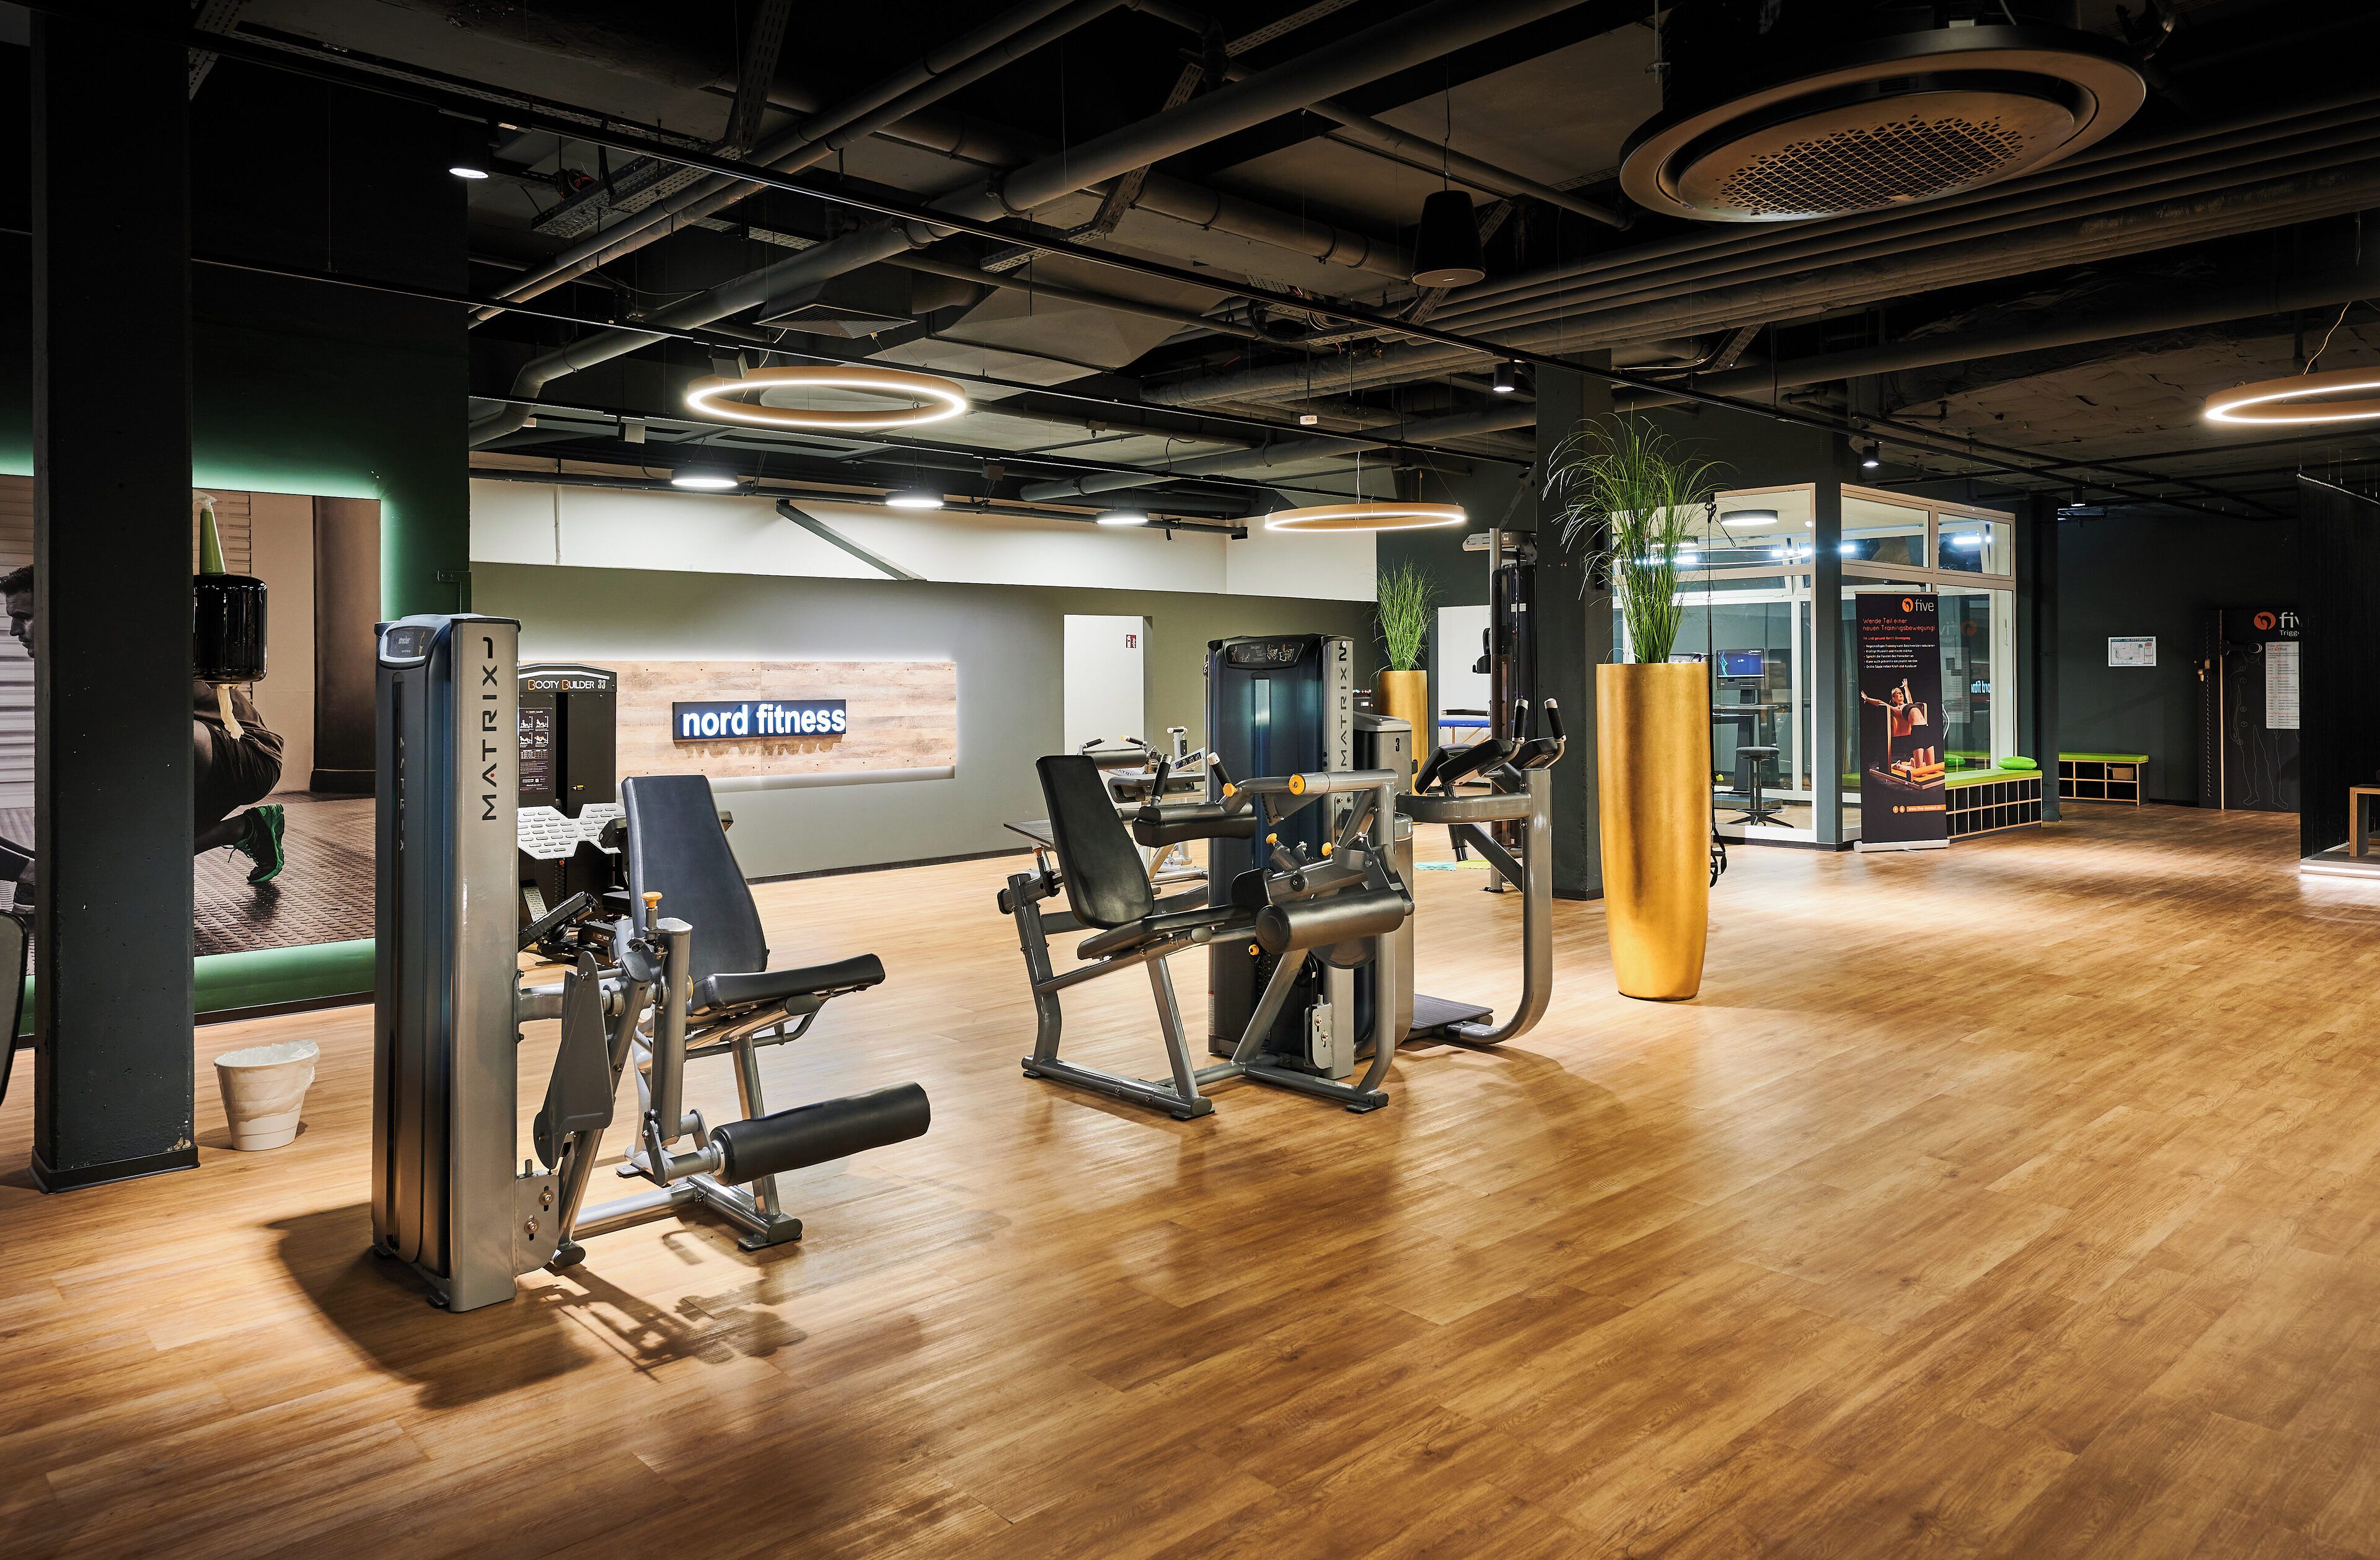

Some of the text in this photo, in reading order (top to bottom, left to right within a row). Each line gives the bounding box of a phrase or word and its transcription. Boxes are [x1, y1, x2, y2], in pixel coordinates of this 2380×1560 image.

[1915, 599, 1934, 612] five
[2279, 612, 2299, 628] fiv
[482, 637, 493, 659] 1
[527, 679, 606, 690] BOOTY BUILDER 33
[682, 703, 847, 737] nord fitness
[482, 664, 498, 821] MATRIX
[1395, 738, 1400, 752] 3
